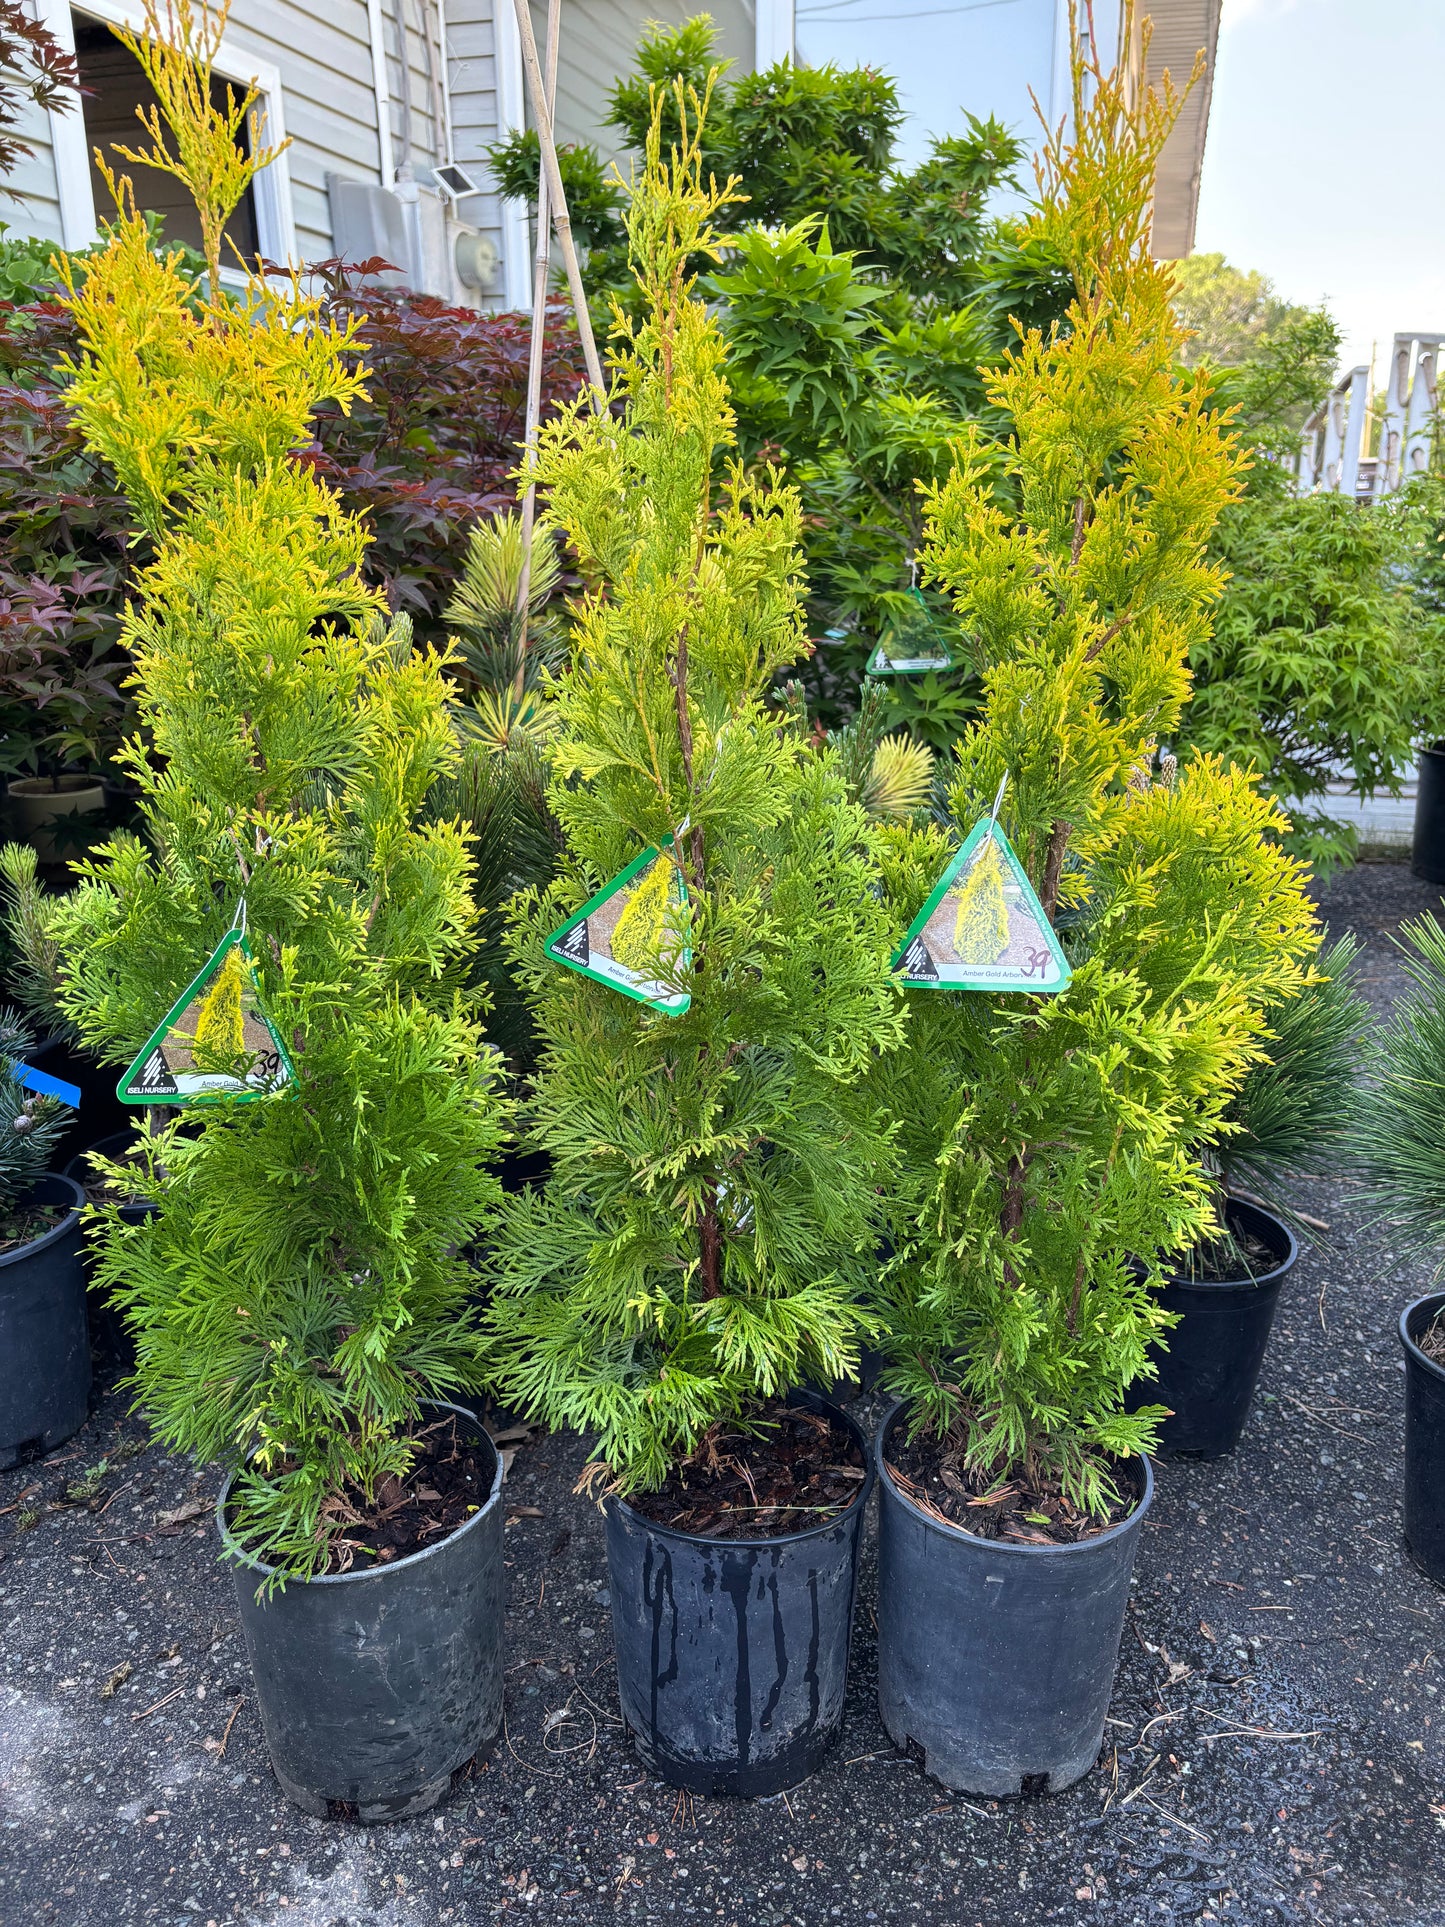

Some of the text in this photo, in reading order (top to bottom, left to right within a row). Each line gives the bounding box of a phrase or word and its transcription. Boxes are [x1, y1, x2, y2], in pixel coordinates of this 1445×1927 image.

[563, 950, 588, 966] NURSERY
[1020, 946, 1051, 979] 39
[608, 966, 625, 978] Amber
[907, 973, 937, 982] NURSERY
[985, 970, 1001, 978] Gold
[253, 1049, 280, 1079] 39
[144, 1086, 176, 1094] NURSERY
